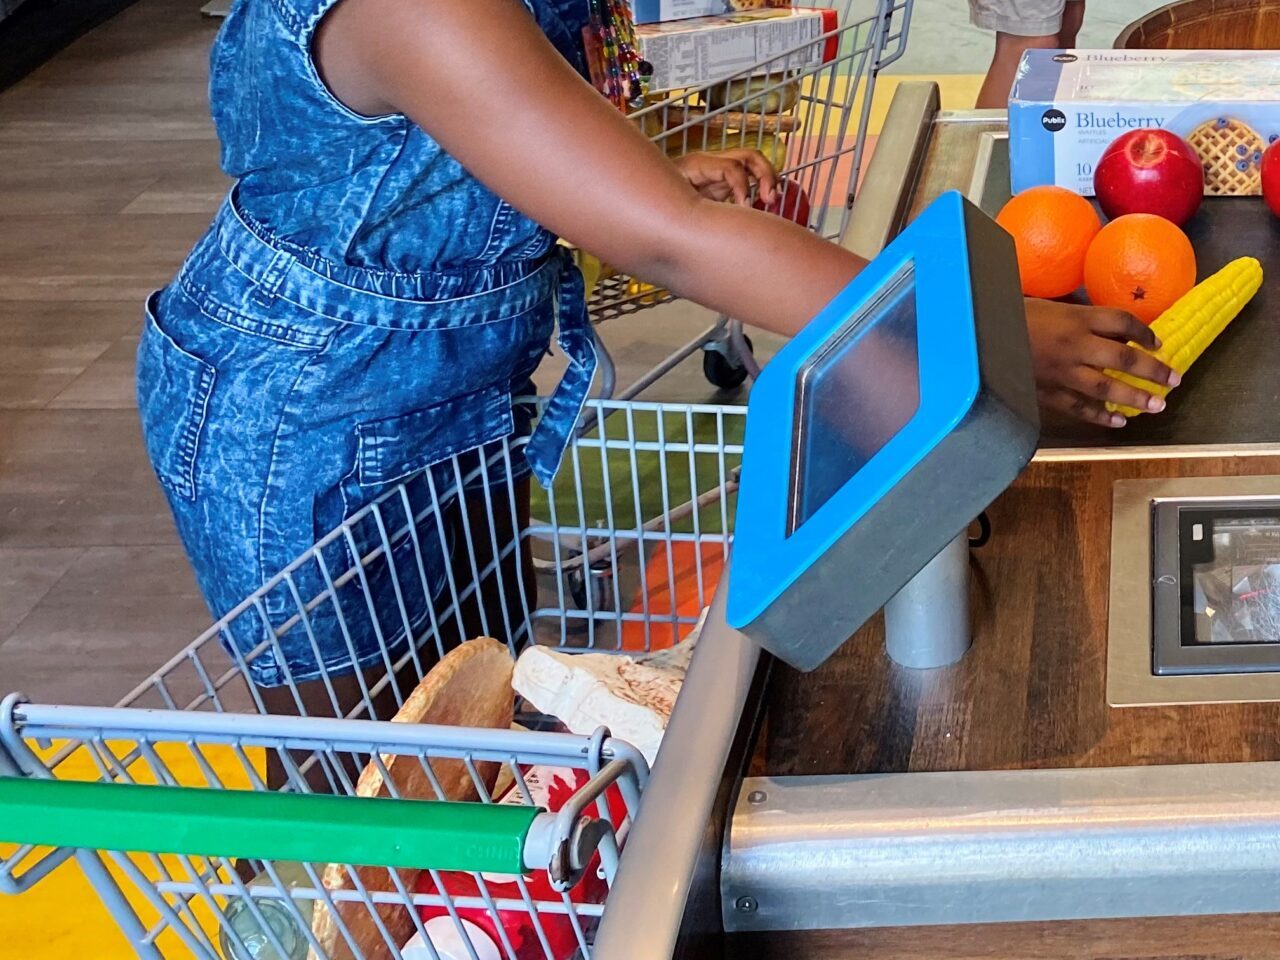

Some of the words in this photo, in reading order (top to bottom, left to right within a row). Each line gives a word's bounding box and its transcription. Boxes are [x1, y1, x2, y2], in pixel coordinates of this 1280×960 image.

[1086, 54, 1169, 62] Blueberry
[1042, 116, 1065, 124] Publix
[1075, 112, 1165, 129] Blueberry
[1076, 163, 1092, 176] 10
